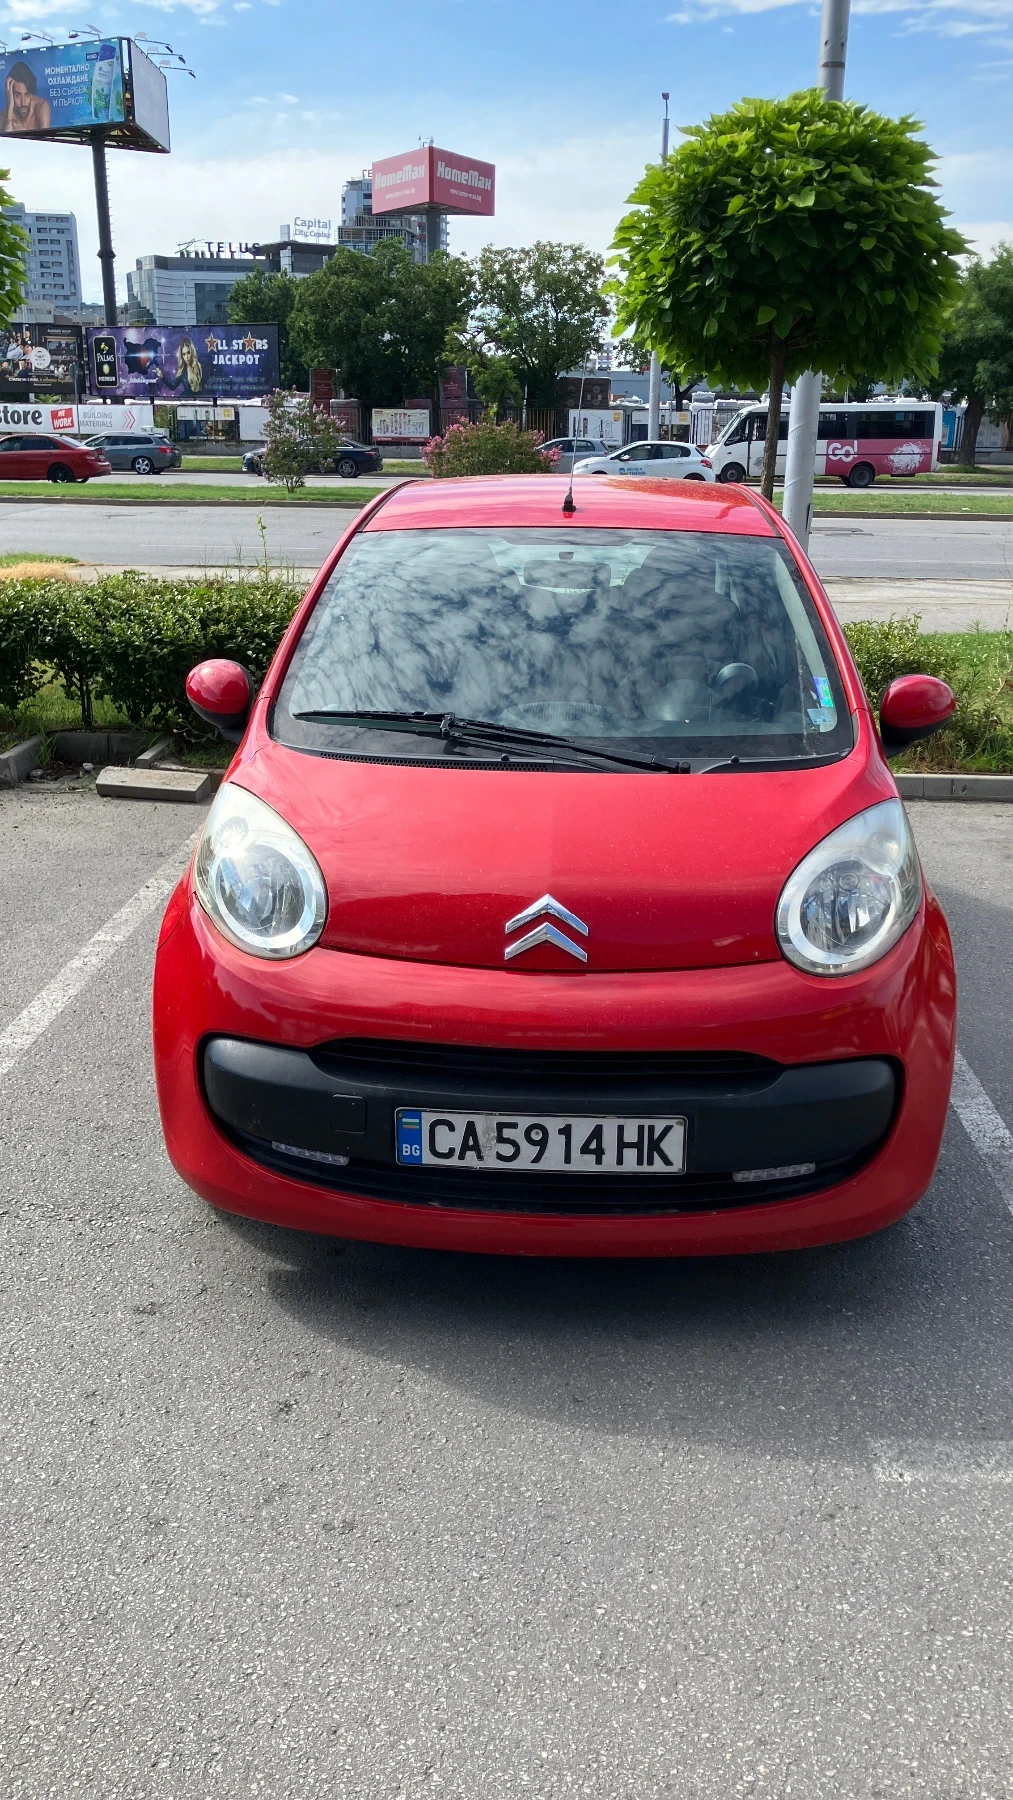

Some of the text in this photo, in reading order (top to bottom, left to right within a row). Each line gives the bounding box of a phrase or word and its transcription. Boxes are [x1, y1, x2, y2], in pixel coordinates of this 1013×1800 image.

[45, 63, 90, 75] МОМЕНТАЛНО
[48, 74, 89, 86] ОХЛАЖДАНЕ
[49, 86, 88, 97] БЕЗ СЪРБЕЖ
[53, 99, 58, 107] И
[375, 164, 425, 189] HomeMax
[437, 161, 492, 190] HomeMax
[294, 216, 331, 230] Capital
[295, 229, 309, 237] City
[205, 241, 260, 254] TELUS
[96, 352, 115, 362] PALMS
[213, 354, 260, 365] JACKPOT
[57, 409, 66, 417] WE
[83, 411, 113, 419] BUILDING
[53, 418, 73, 428] WORK
[79, 420, 113, 428] MATERIALS
[402, 1144, 420, 1156] BG
